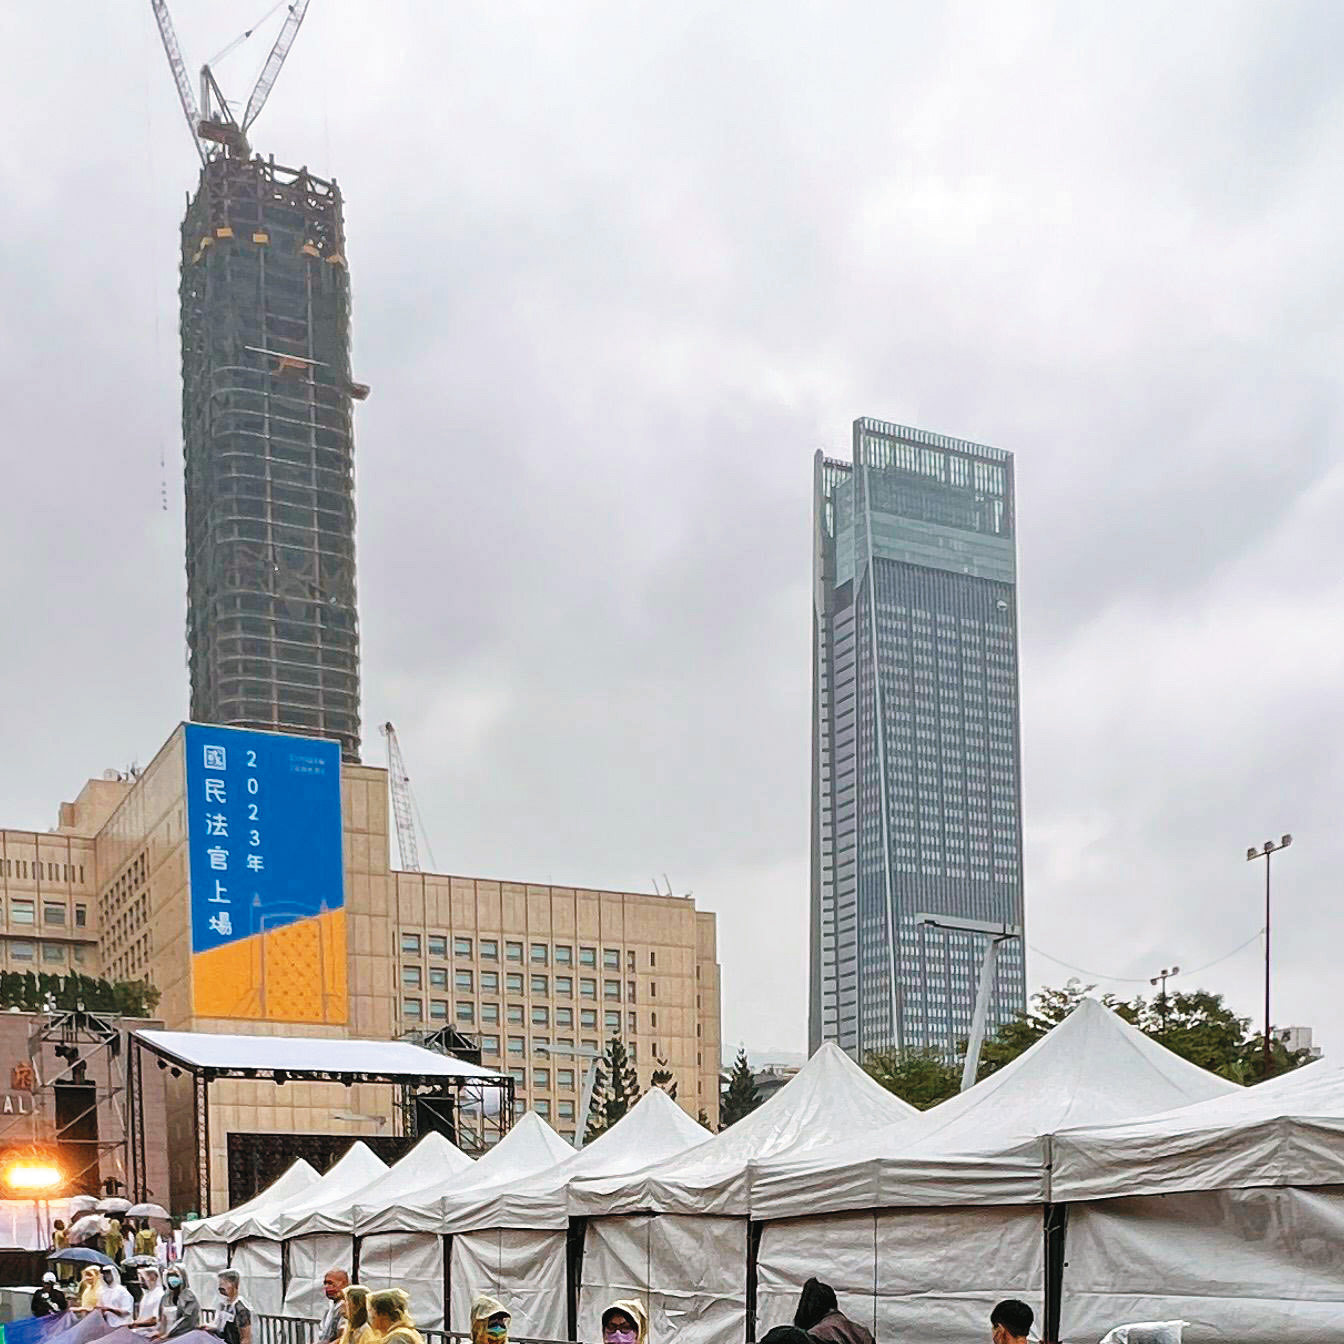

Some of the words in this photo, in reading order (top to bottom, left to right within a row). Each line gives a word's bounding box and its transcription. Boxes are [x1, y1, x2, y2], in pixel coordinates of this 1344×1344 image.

[203, 744, 233, 937] 國民法官上場
[245, 750, 265, 873] 2023年
